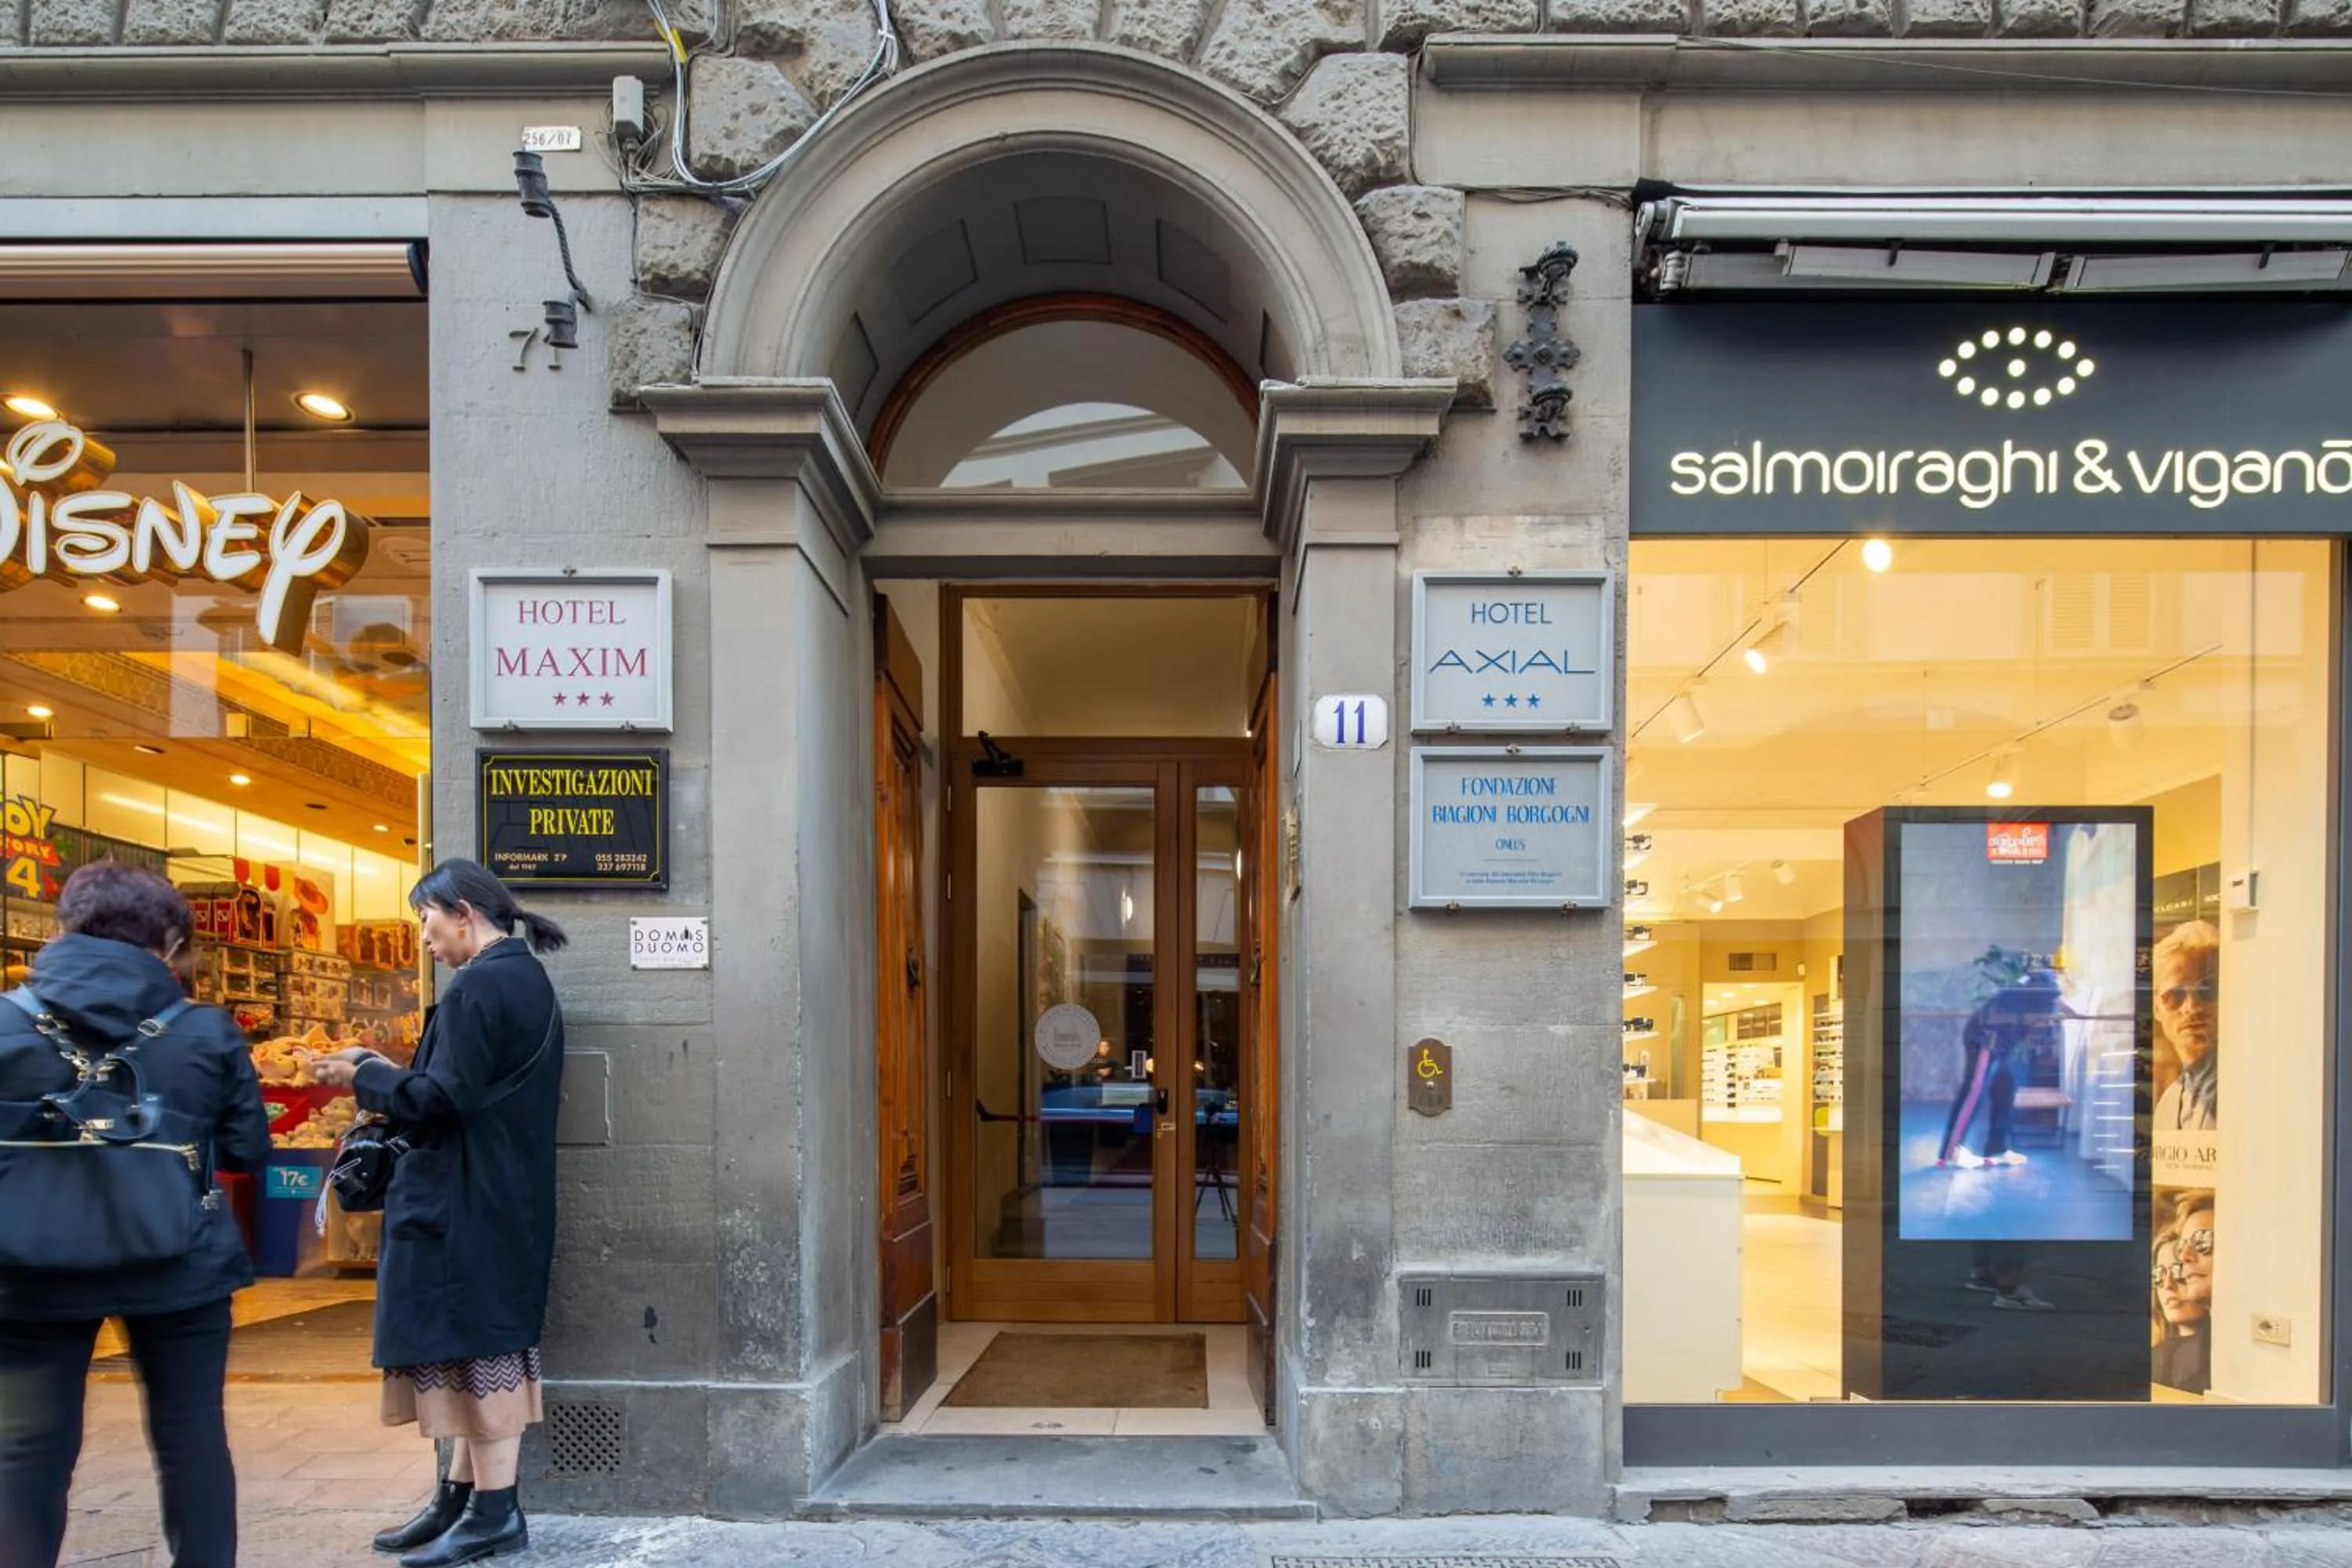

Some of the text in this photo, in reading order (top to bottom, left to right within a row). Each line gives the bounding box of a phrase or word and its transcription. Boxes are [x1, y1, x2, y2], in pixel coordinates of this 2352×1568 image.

[1670, 439, 2058, 509] salmoiraghi
[2073, 438, 2122, 494] &
[518, 601, 626, 624] HOTEL
[1472, 602, 1552, 624] HOTEL
[495, 648, 648, 677] MAXIM
[1429, 649, 1595, 674] AXIAL
[1333, 701, 1366, 744] 11
[491, 769, 652, 796] INVESTIGAZIONI
[1461, 777, 1556, 796] FONDAZIONE
[529, 808, 615, 835] PRIVATE
[1432, 805, 1589, 823] BIAGIONI BORGOGNI
[7, 856, 41, 898] 4
[634, 942, 704, 953] DUOMO
